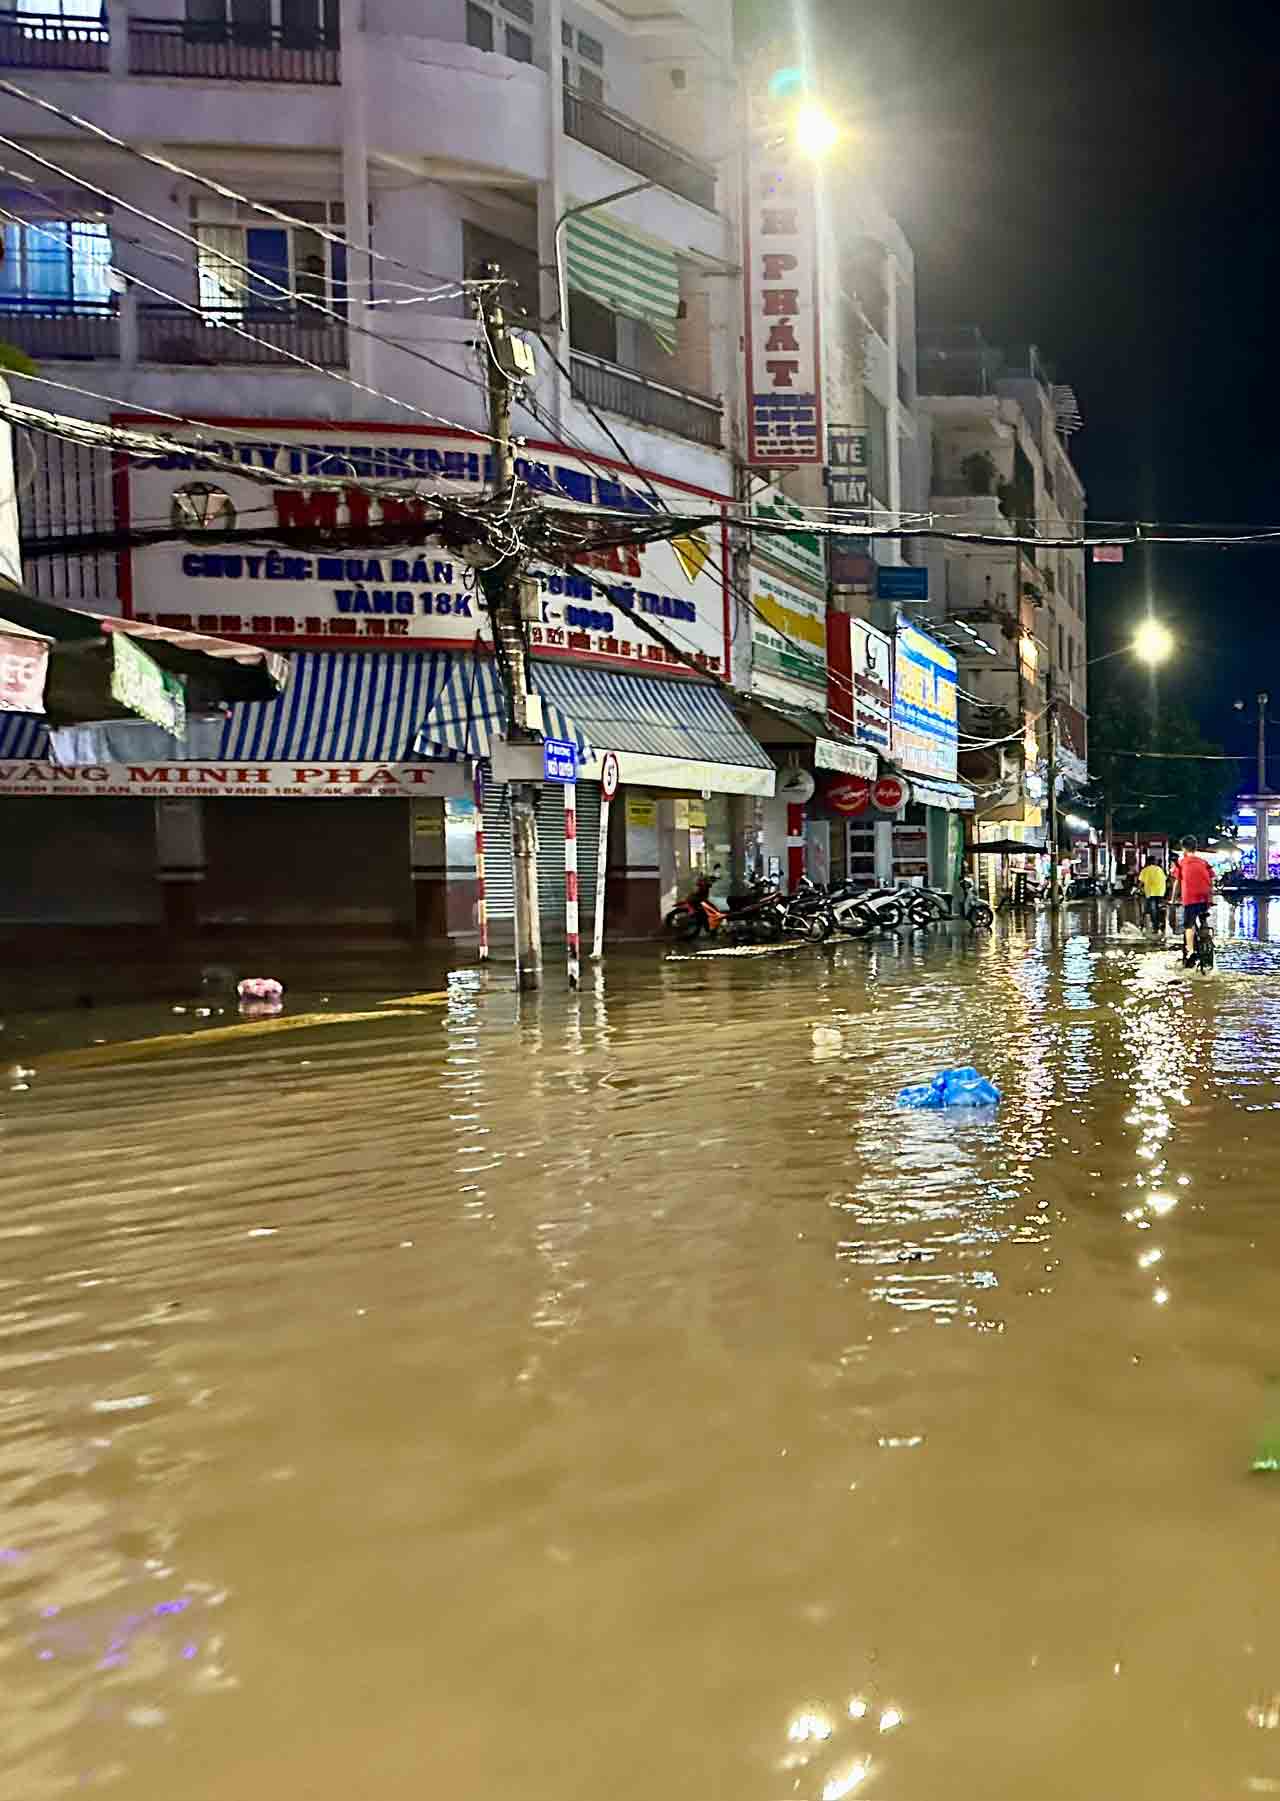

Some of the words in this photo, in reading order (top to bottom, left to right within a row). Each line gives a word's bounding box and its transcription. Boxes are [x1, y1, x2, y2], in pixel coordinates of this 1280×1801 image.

[390, 553, 454, 586] BÁN
[333, 582, 415, 615] VÀNG
[419, 591, 474, 617] 18K
[127, 766, 272, 784] MINH
[293, 764, 436, 784] PHÁT
